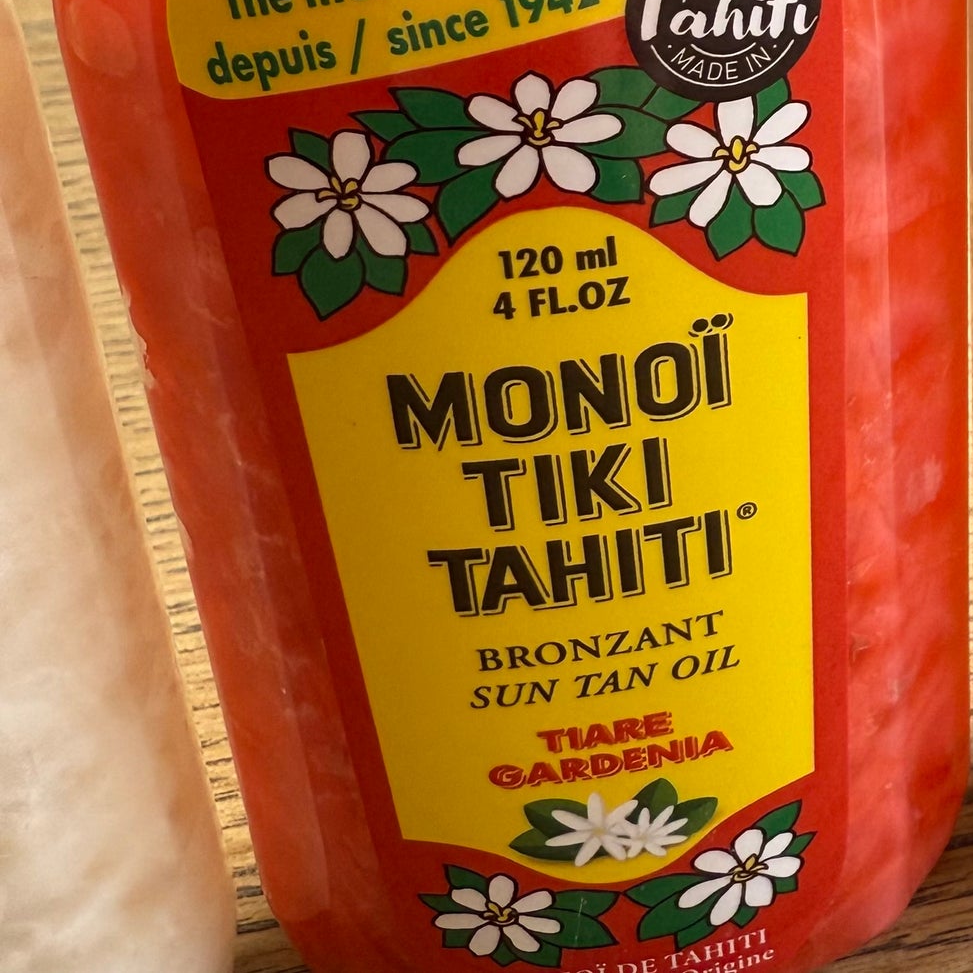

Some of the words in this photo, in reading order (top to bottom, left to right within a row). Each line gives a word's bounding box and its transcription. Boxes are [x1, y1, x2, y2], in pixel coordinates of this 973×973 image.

[206, 32, 337, 92] depuis
[349, 18, 367, 75] /
[387, 5, 490, 57] since
[671, 47, 739, 81] MADE
[746, 47, 771, 73] IN
[498, 245, 563, 280] 120
[575, 235, 618, 271] ml
[493, 292, 516, 320] 4
[529, 276, 631, 318] FL.OZ
[386, 312, 734, 451] MONOÏ
[461, 436, 673, 532] TIKI
[476, 610, 724, 672] BRONZANT
[469, 679, 559, 710] SUN
[574, 663, 656, 700] TAN
[672, 645, 740, 681] OIL
[488, 730, 733, 790] GARDENIA
[537, 710, 674, 755] TIARE
[664, 928, 767, 969] TAHITI
